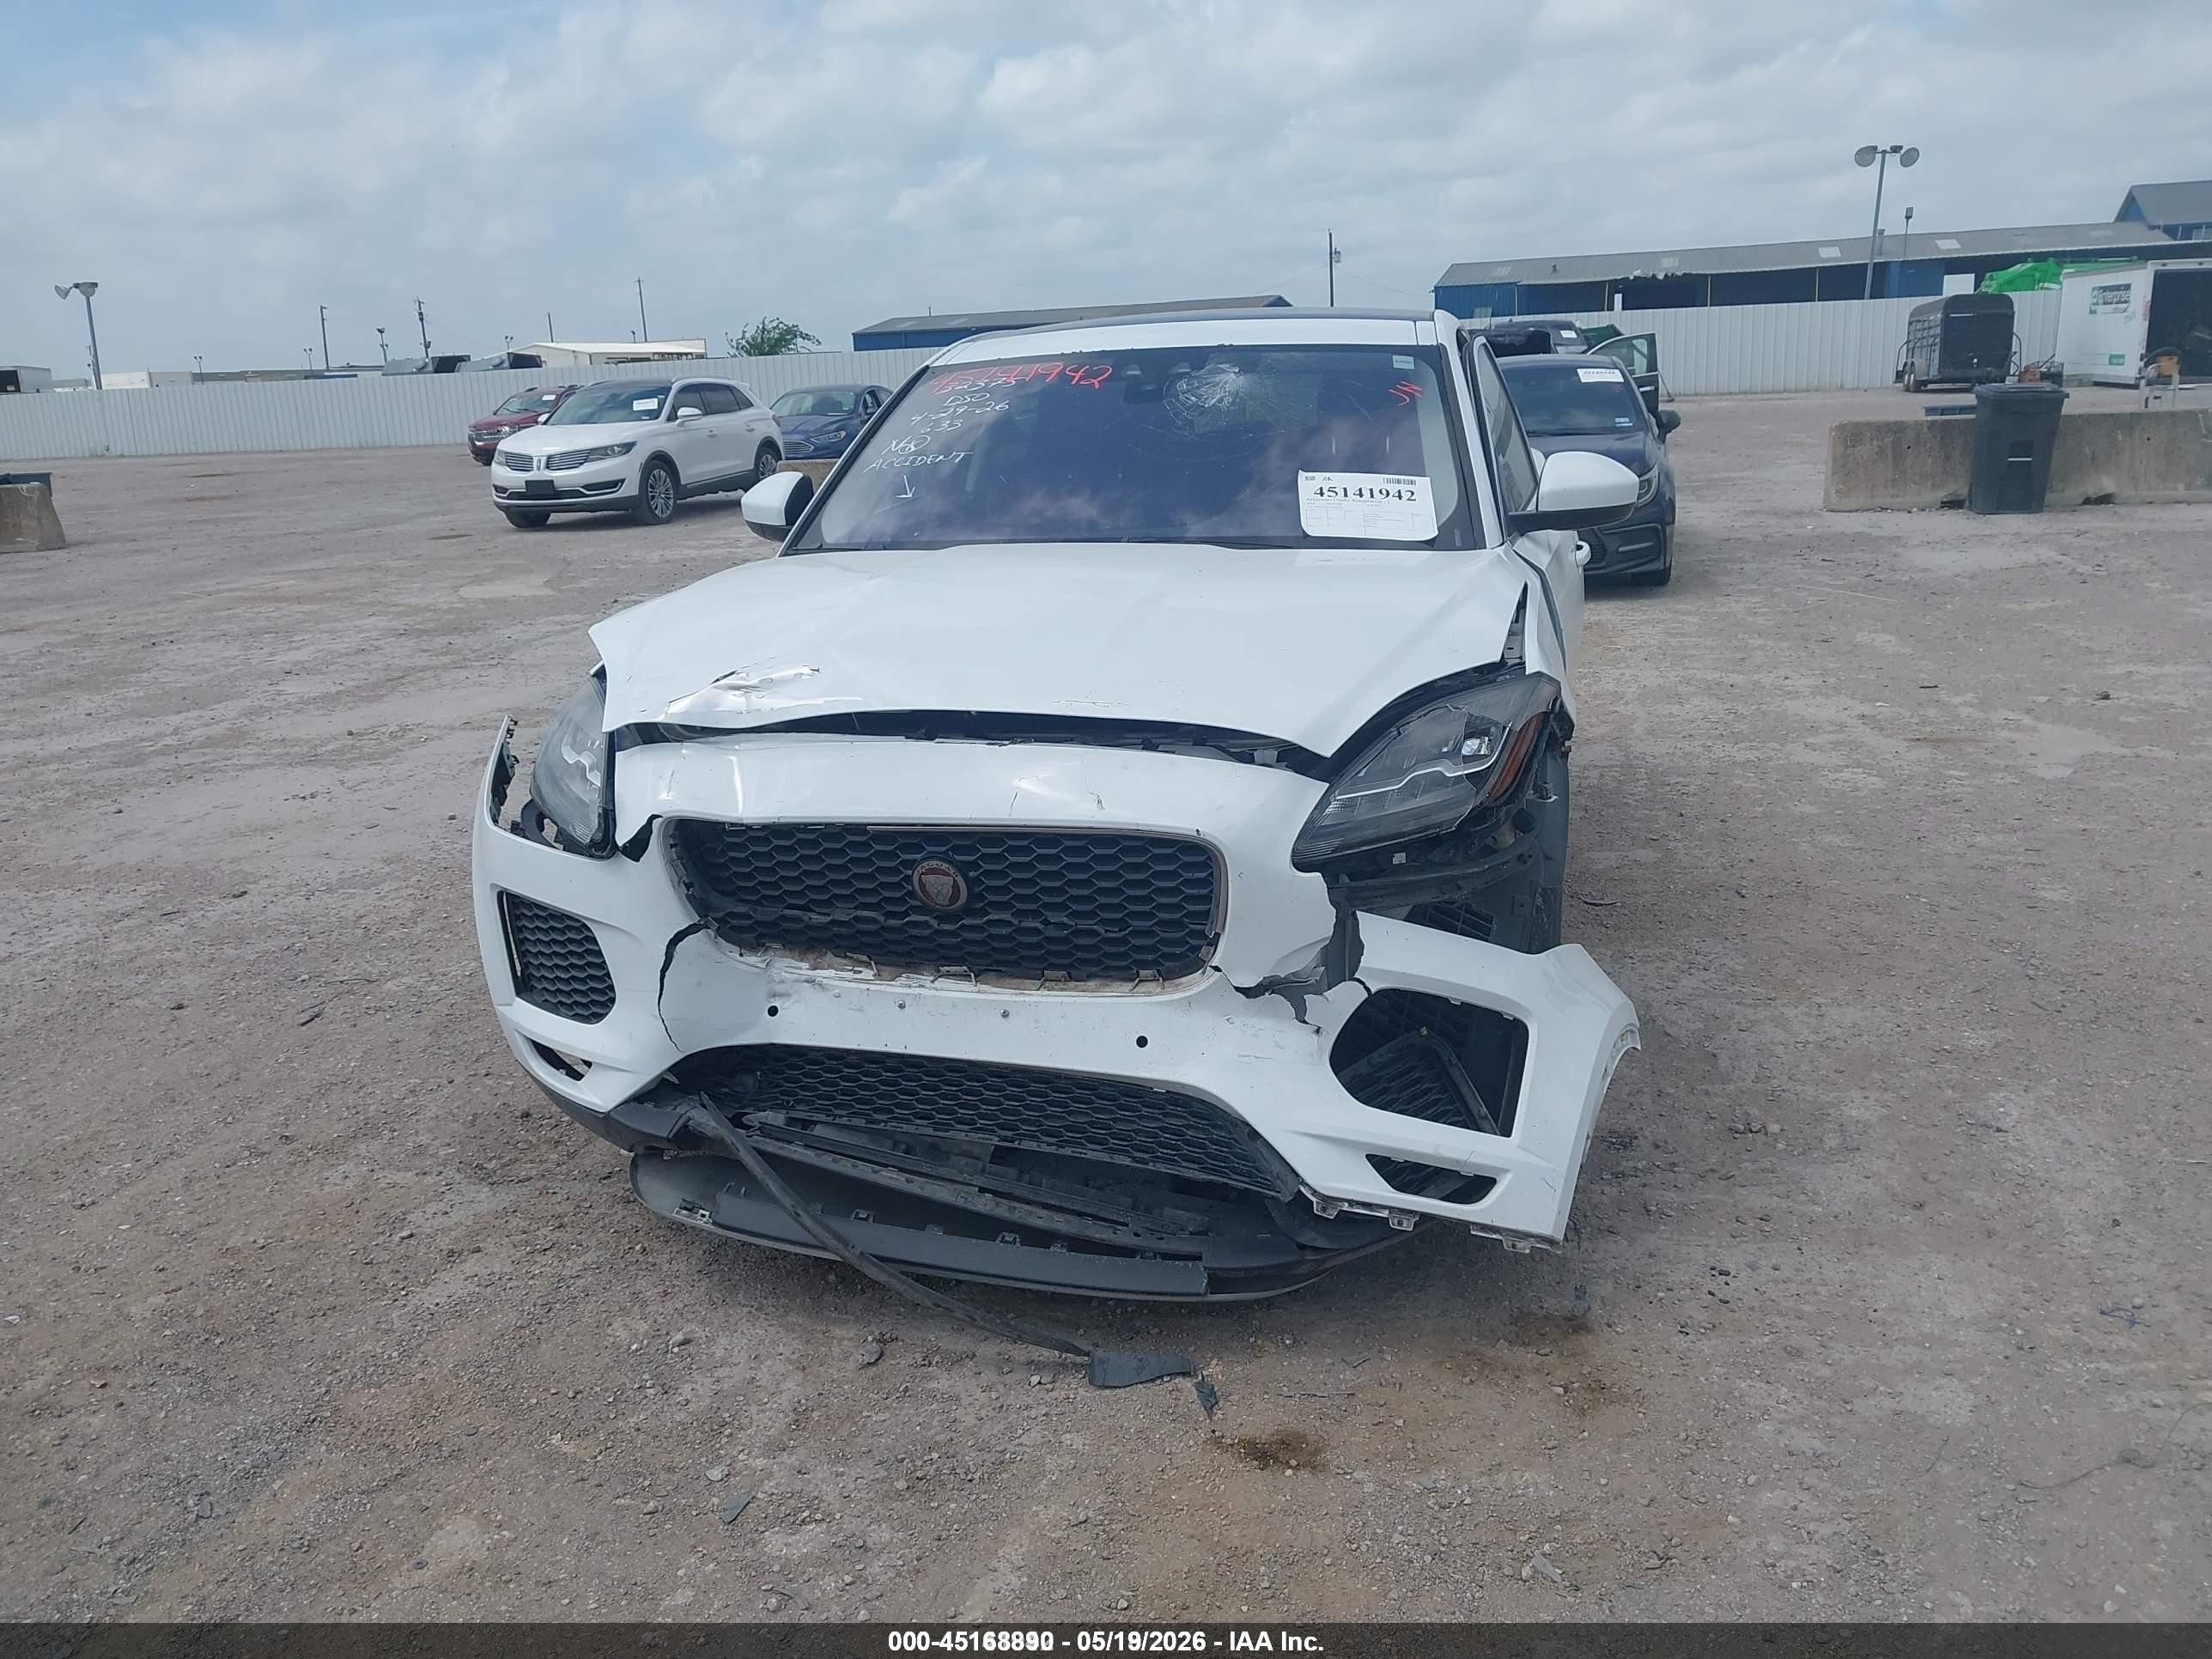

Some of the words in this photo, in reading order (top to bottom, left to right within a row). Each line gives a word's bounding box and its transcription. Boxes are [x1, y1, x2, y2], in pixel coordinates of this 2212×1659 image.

[920, 418, 964, 434] 633
[862, 452, 975, 473] ACCIDENT
[1313, 486, 1417, 502] 45141942
